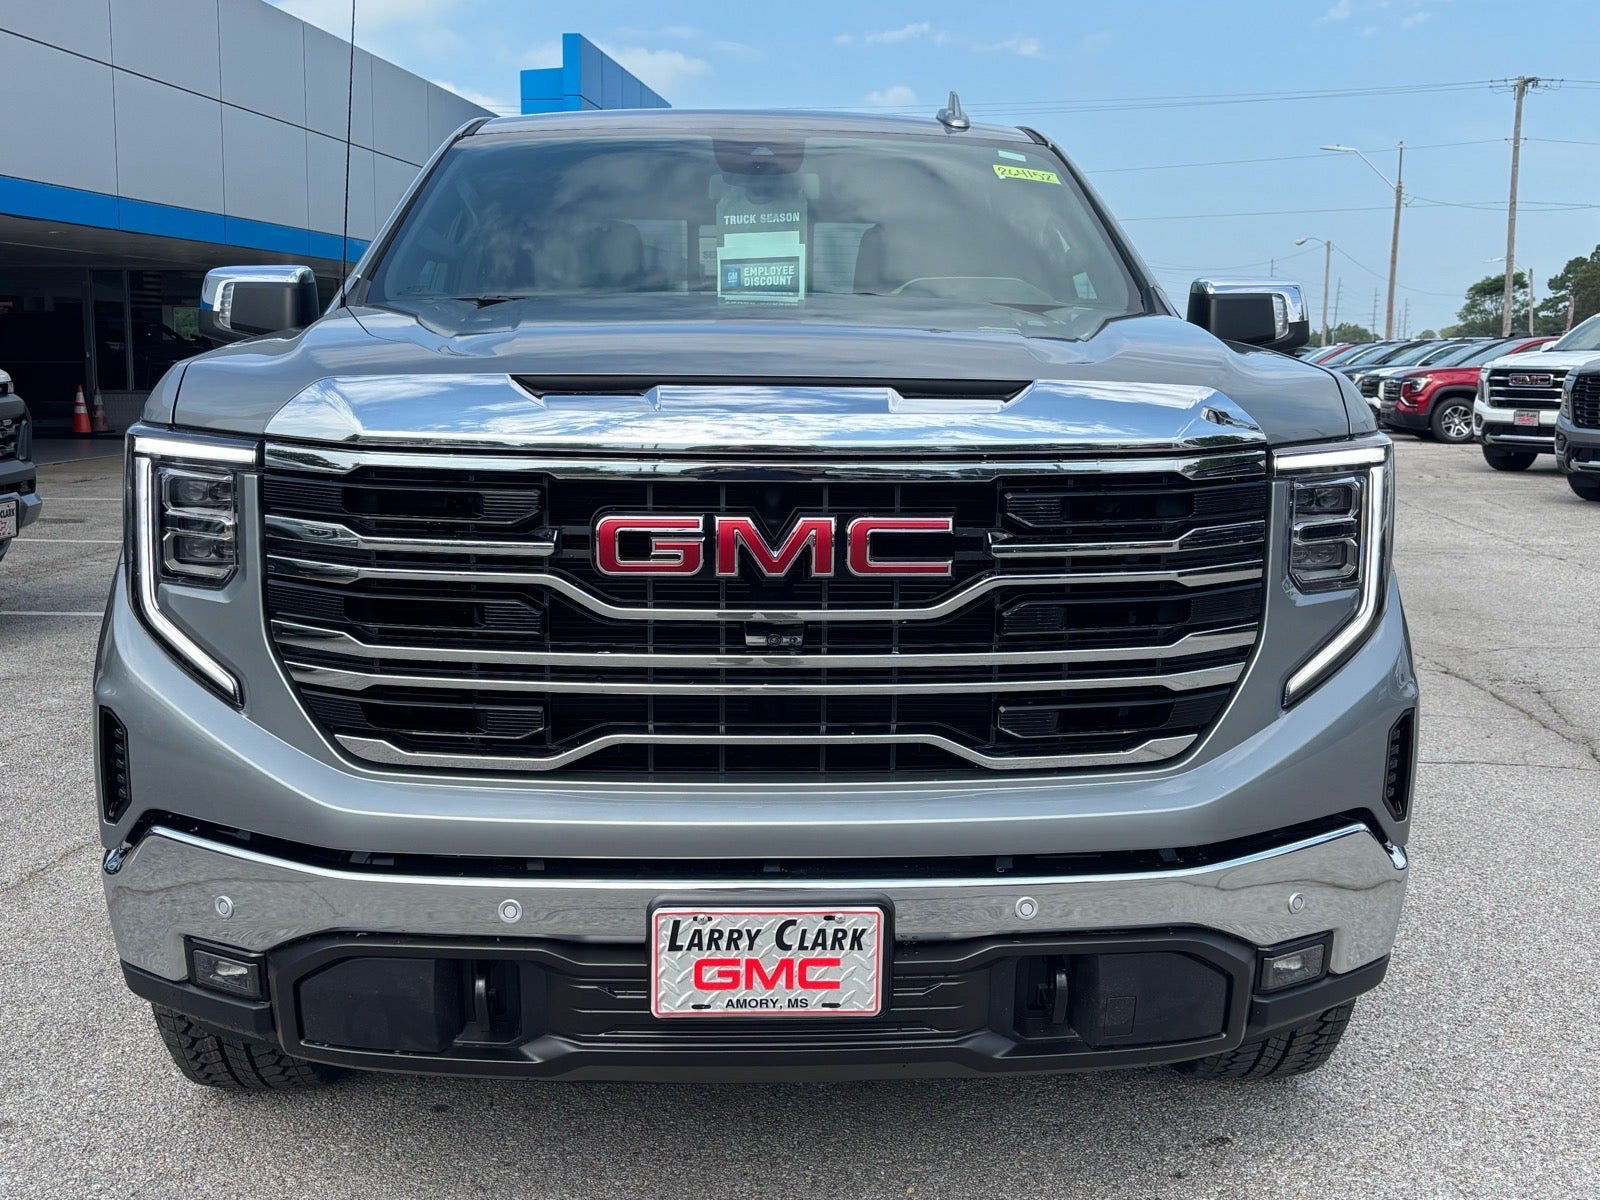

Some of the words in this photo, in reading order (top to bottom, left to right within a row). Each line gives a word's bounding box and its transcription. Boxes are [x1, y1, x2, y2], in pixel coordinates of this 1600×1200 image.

[723, 214, 757, 225] TRUCK
[760, 212, 800, 223] SEASON
[727, 271, 738, 280] GM
[744, 265, 795, 277] EMPLOYEE
[744, 275, 793, 287] DISCOUNT
[596, 515, 954, 576] GMC
[667, 919, 762, 951] LARRY
[775, 919, 867, 951] CLARK
[693, 957, 841, 991] GMC
[725, 998, 783, 1010] AMORY,
[787, 998, 809, 1009] MS
